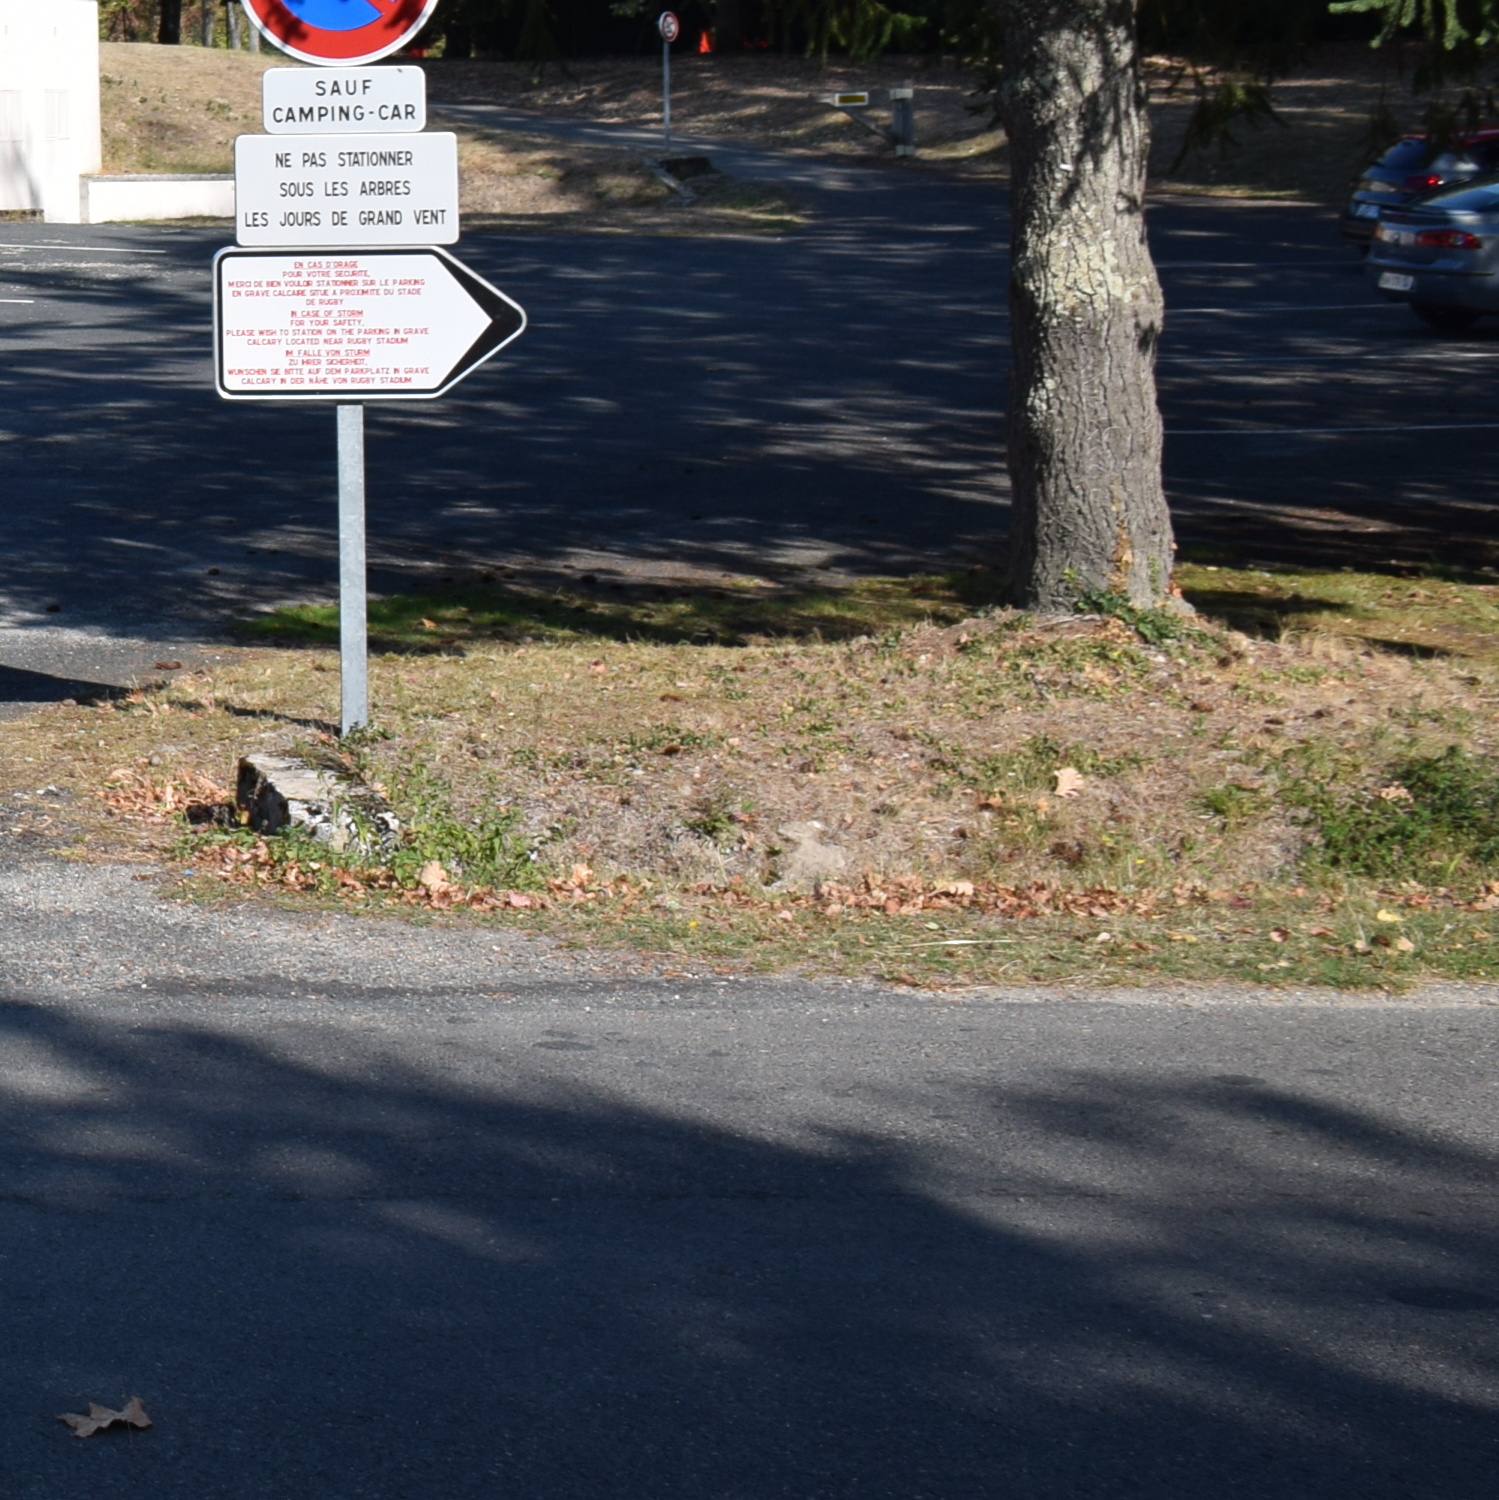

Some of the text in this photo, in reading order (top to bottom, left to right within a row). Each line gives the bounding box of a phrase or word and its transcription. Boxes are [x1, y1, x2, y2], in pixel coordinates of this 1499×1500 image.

[315, 79, 373, 97] SAUF
[272, 103, 416, 123] CAMPING-CAR
[274, 151, 413, 168] NE PAS STATIONNER
[279, 180, 411, 197] SOUS LES ARBRES
[244, 209, 446, 228] LES JOURS DE GRAND VENT
[282, 270, 302, 278] POUR
[306, 270, 331, 278] VOTRE
[227, 280, 251, 288] MERCI
[254, 280, 262, 288] DE
[265, 280, 281, 288] BIEN
[362, 279, 376, 287] SUR
[380, 279, 389, 287] LE
[393, 279, 425, 287] PARKING
[244, 289, 271, 297] GRAVE
[272, 289, 307, 297] CALCAIRE
[384, 288, 394, 296] DU
[398, 288, 421, 296] STADE
[318, 298, 343, 306] RUGBY
[300, 310, 321, 318] CASE
[290, 319, 305, 327] FOR
[309, 319, 330, 327] YOUR
[226, 329, 255, 337] PLEASE
[257, 329, 276, 337] WISH
[327, 328, 337, 336] ON
[341, 328, 354, 336] THE
[357, 328, 390, 336] PARKING
[247, 338, 282, 346] CALCARY
[346, 337, 371, 345] RUGBY
[376, 337, 408, 345] STADIUM
[325, 349, 341, 357] VON
[344, 349, 371, 357] STURM
[307, 367, 321, 375] AUF
[325, 367, 342, 375] DEM
[344, 367, 389, 375] PARKPLATZ
[403, 366, 429, 374] GRAVE
[241, 377, 276, 385] CALCARY
[332, 376, 349, 384] VON
[350, 376, 374, 384] RUGBY
